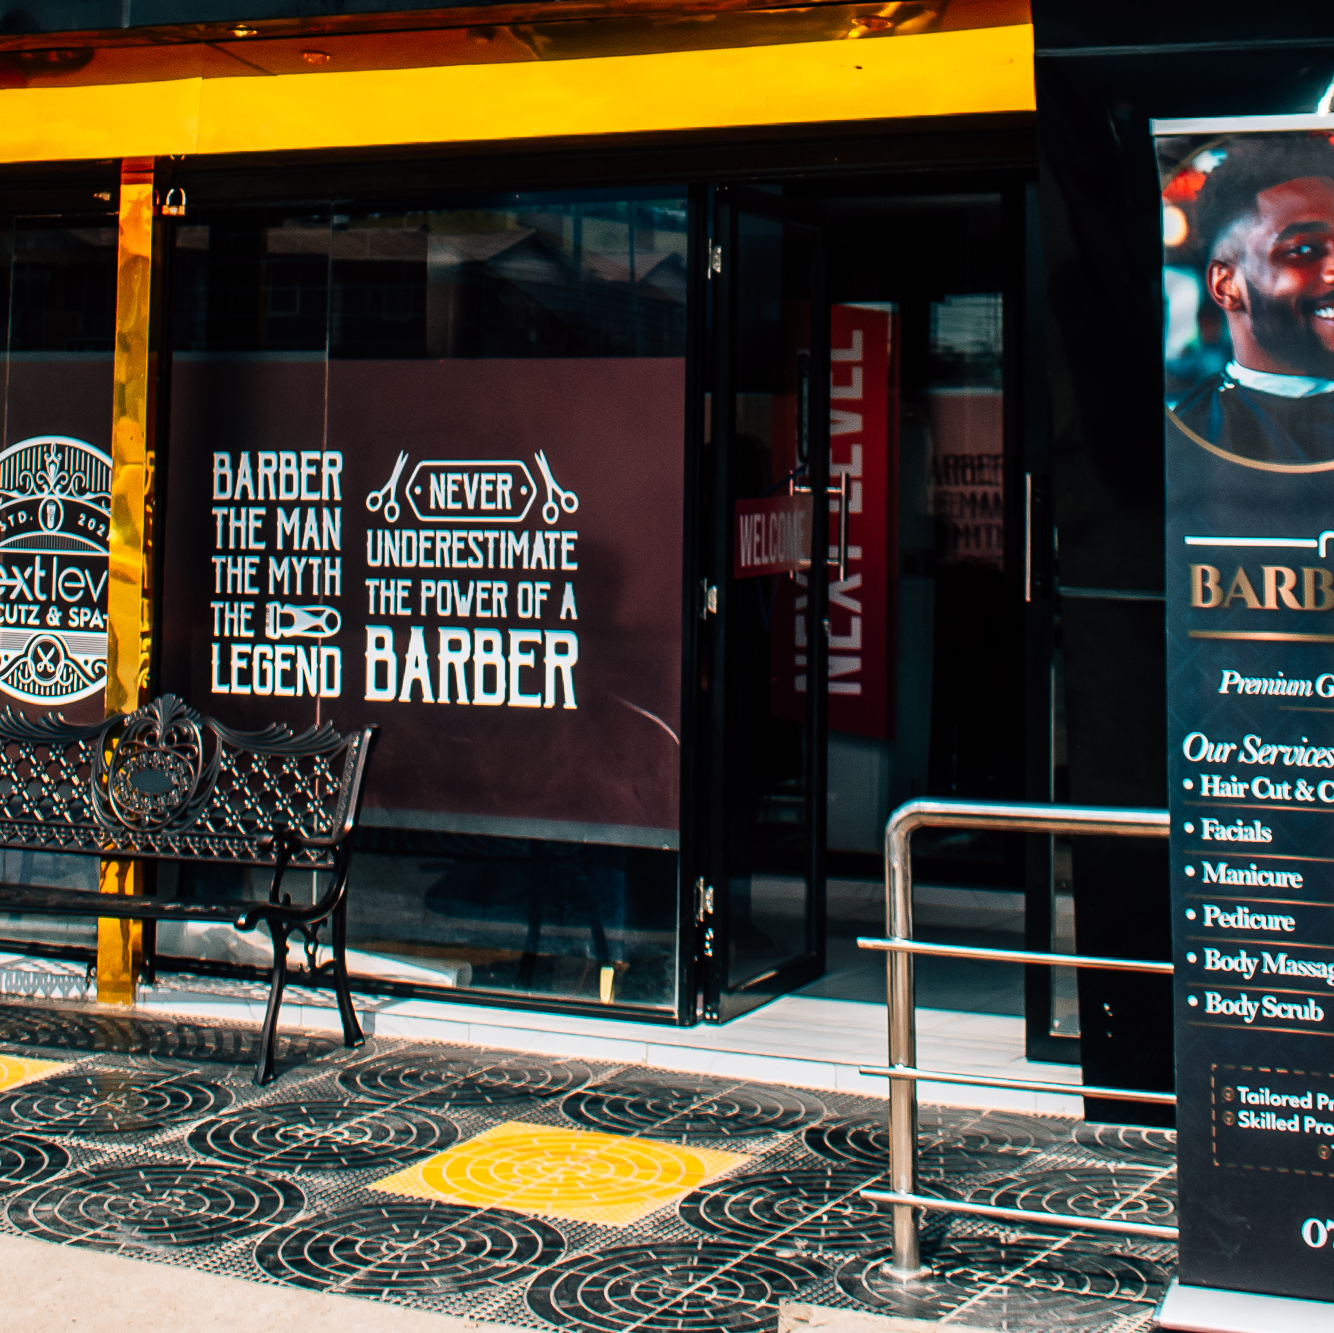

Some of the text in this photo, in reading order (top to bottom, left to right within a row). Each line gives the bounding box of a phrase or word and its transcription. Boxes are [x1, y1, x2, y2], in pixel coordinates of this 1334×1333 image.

[213, 450, 343, 501] BARBER
[429, 472, 513, 511] NEVER
[77, 513, 110, 541] 202
[212, 507, 342, 551] THE MAN
[739, 507, 809, 568] WELCOME
[366, 529, 579, 571] UNDERESTIMATE
[212, 556, 342, 597] THE MYTH
[365, 578, 578, 620] THE POWER OF A
[46, 605, 62, 626] &
[68, 606, 104, 628] SPA
[210, 601, 255, 638] THE
[210, 643, 342, 698] LEGEND
[364, 624, 579, 710] BARBER
[1218, 670, 1313, 698] Premium
[1183, 732, 1237, 763] Our
[1200, 774, 1249, 798] Hair
[1251, 776, 1293, 800] Cut
[1294, 778, 1315, 802] &
[1200, 818, 1273, 843] Facials
[1201, 861, 1303, 889] Manicure
[1202, 904, 1296, 932] Pedicure
[1204, 947, 1259, 980] Body
[1205, 991, 1325, 1024] Body Scrub
[1236, 1085, 1313, 1109] Tailored
[1237, 1110, 1300, 1133] Skilled
